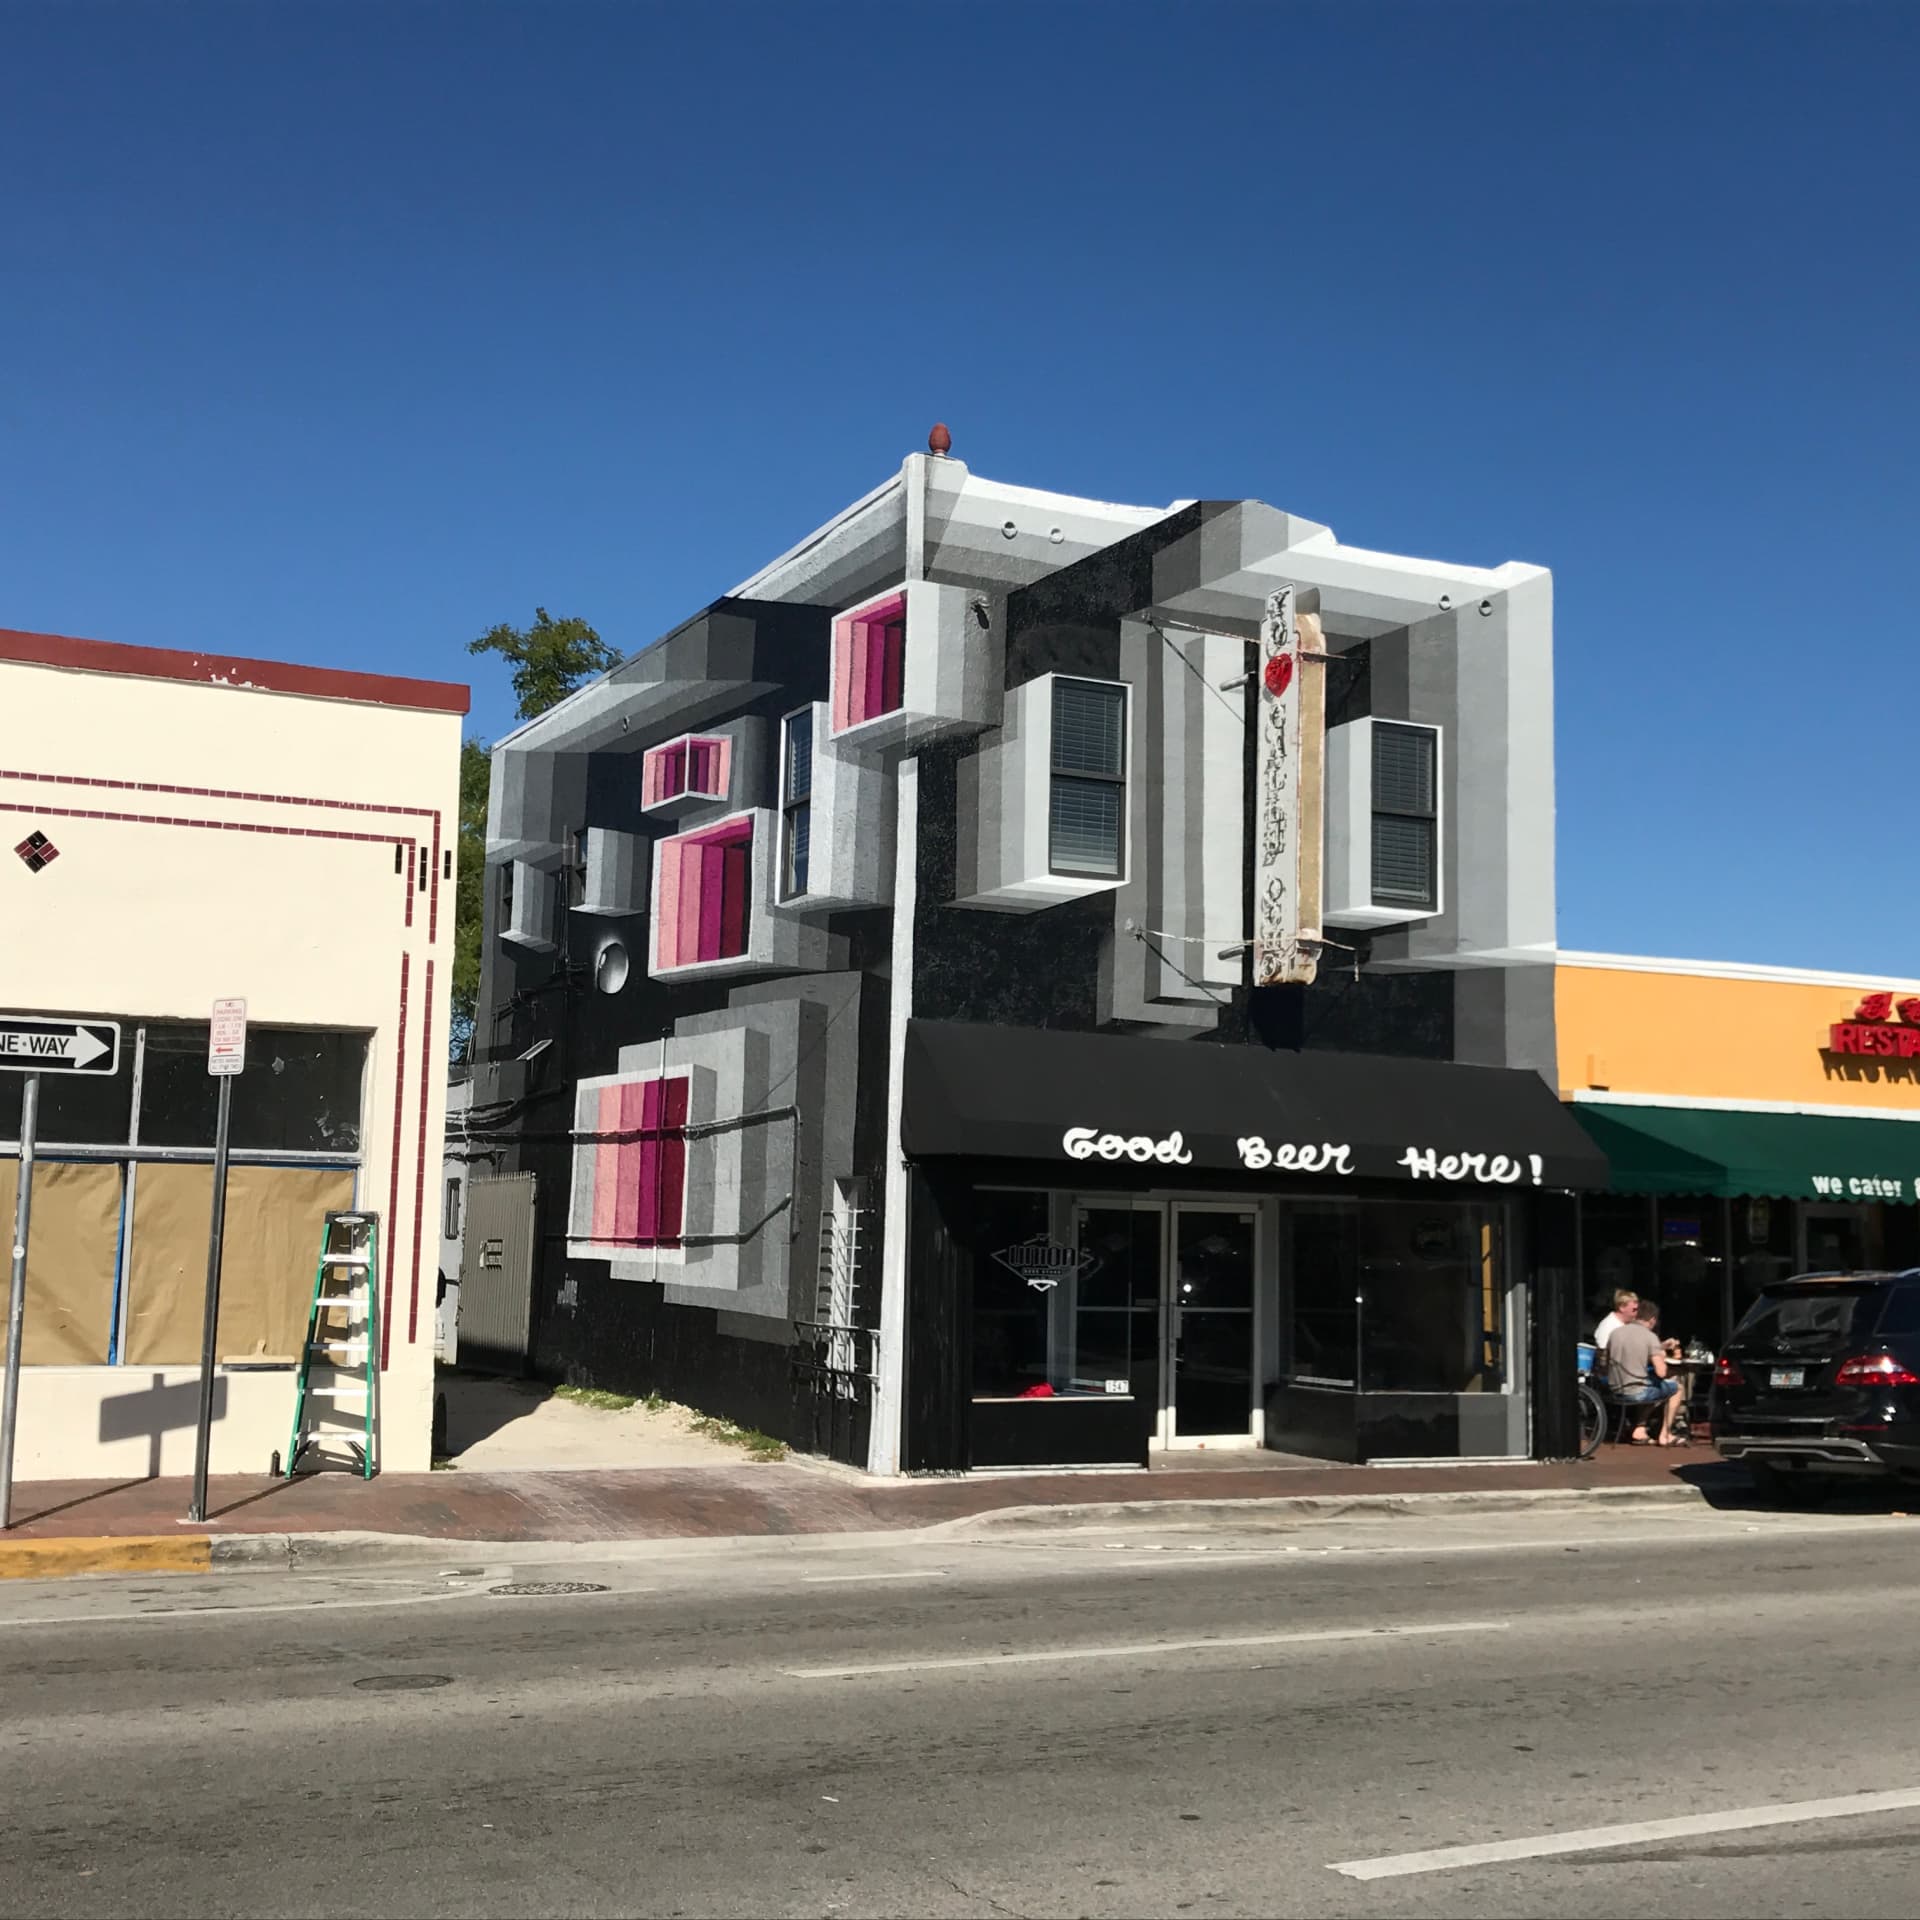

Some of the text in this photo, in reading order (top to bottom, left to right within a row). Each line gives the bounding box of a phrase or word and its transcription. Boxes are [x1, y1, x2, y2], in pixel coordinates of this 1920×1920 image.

[29, 1036, 70, 1055] WAY
[1062, 1127, 1543, 1186] Good Beer Here!
